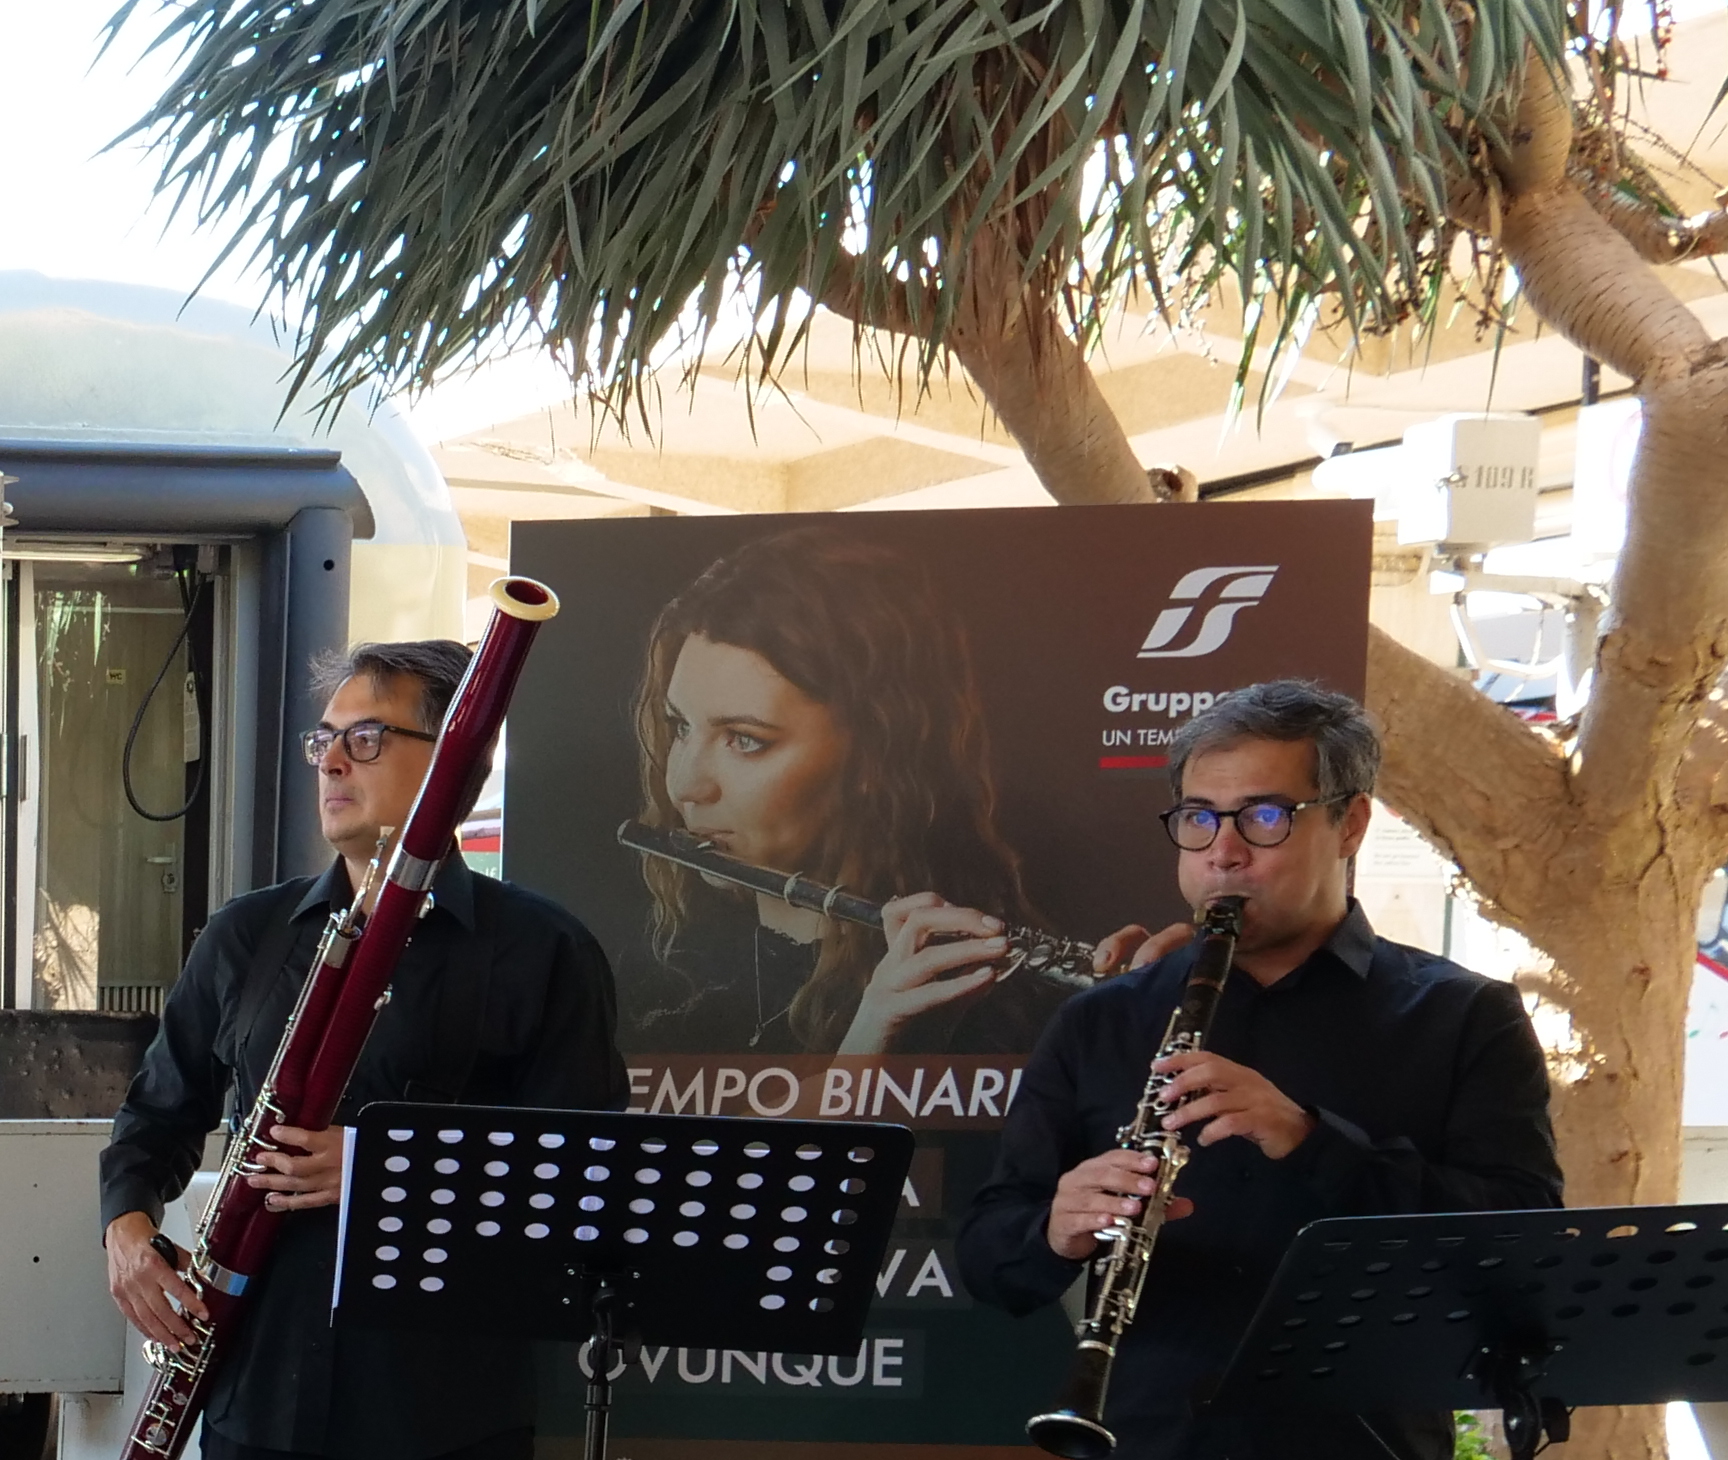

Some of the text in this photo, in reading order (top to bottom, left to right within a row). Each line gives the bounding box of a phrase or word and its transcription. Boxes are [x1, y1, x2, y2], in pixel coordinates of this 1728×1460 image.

[1475, 465, 1514, 489] 109
[109, 672, 123, 681] WC
[1102, 729, 1180, 746] UN TEM
[625, 1067, 1024, 1118] EMPO BINARI
